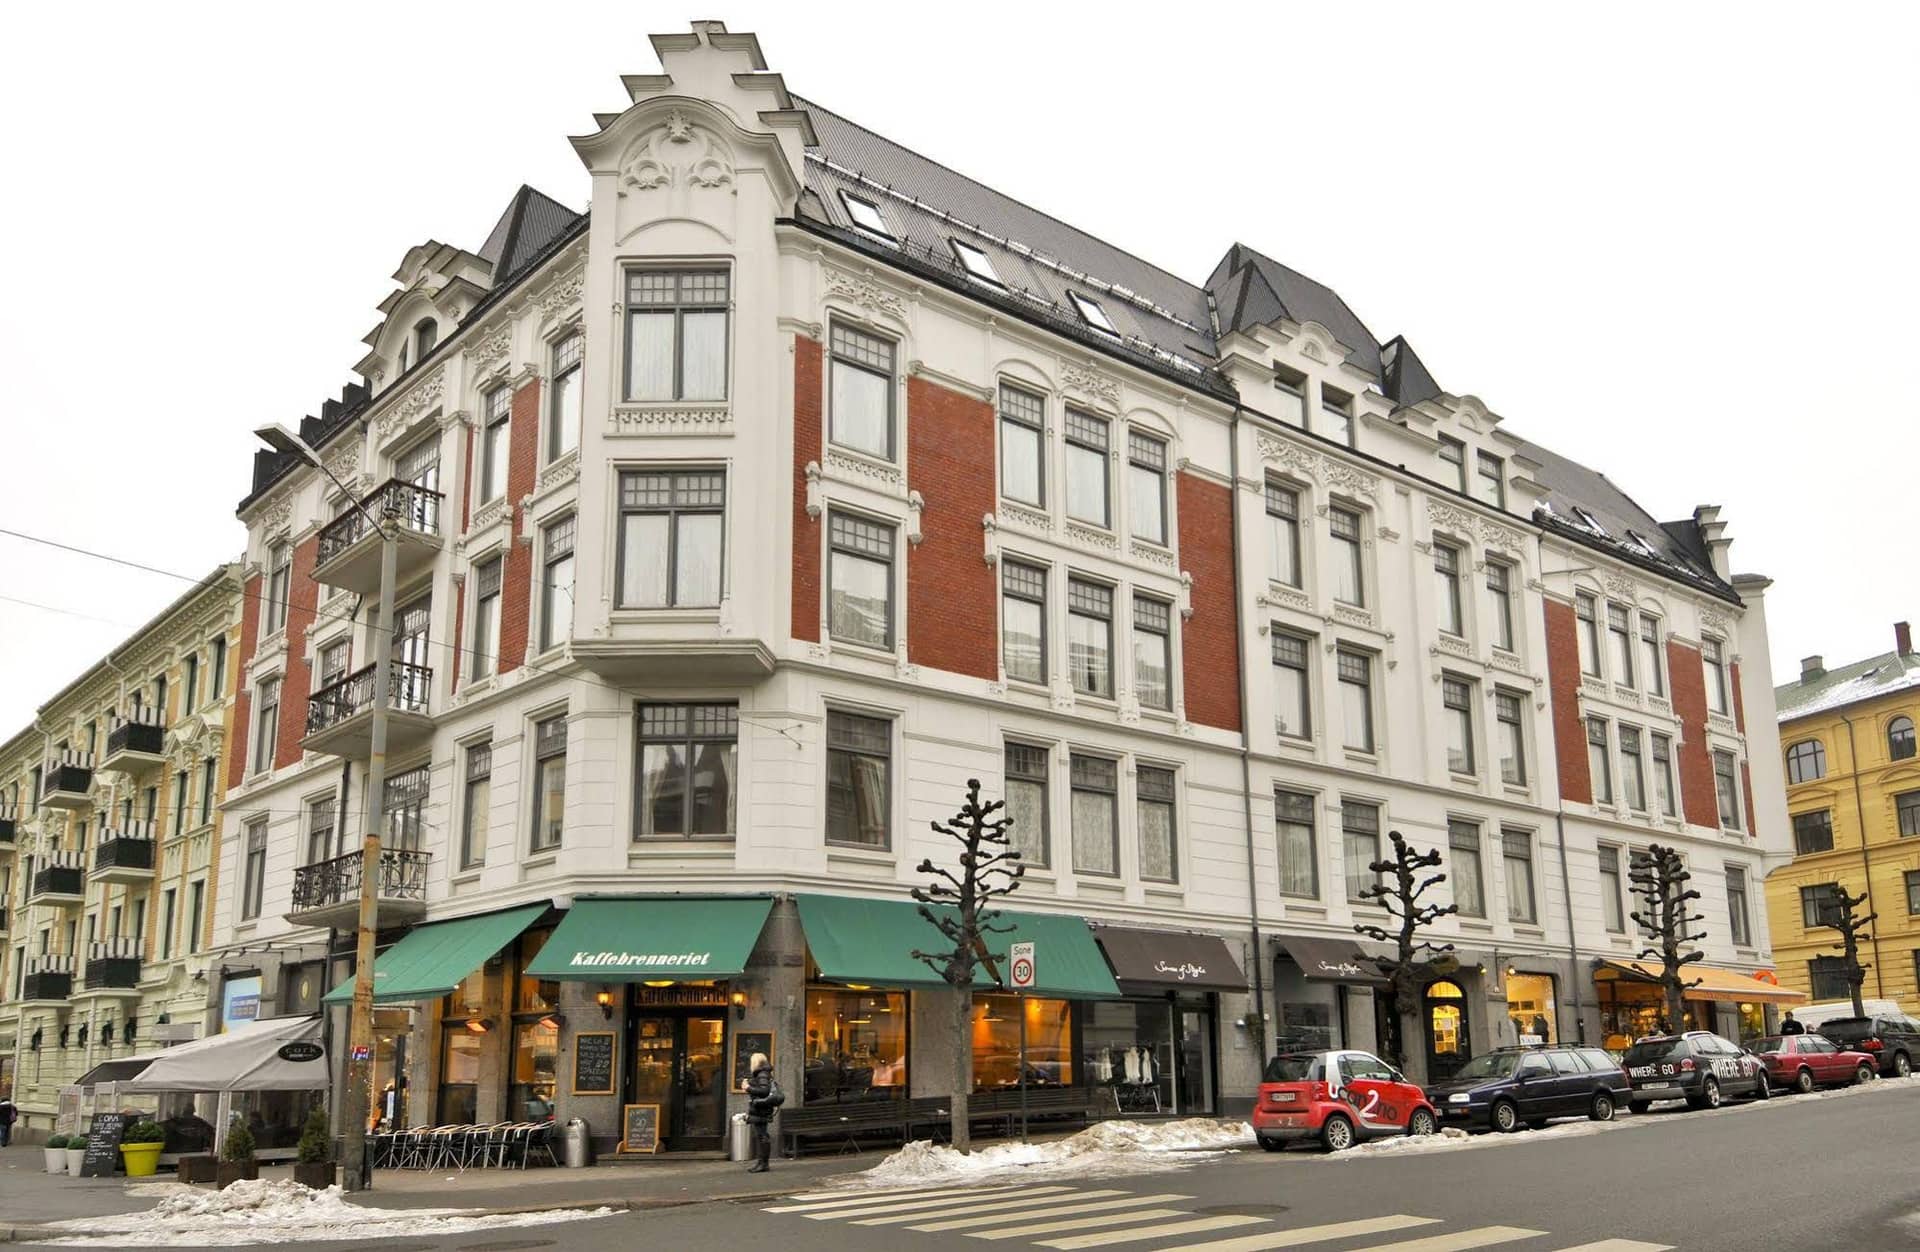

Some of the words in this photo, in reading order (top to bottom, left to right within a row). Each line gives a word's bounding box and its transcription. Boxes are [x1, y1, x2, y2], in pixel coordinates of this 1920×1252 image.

[1013, 946, 1031, 955] Sone
[569, 951, 710, 966] Kaffebrenneriet
[1017, 966, 1028, 976] 30
[1628, 1064, 1658, 1078] WHERE
[1661, 1063, 1674, 1075] GO
[1710, 1058, 1740, 1078] WHERE
